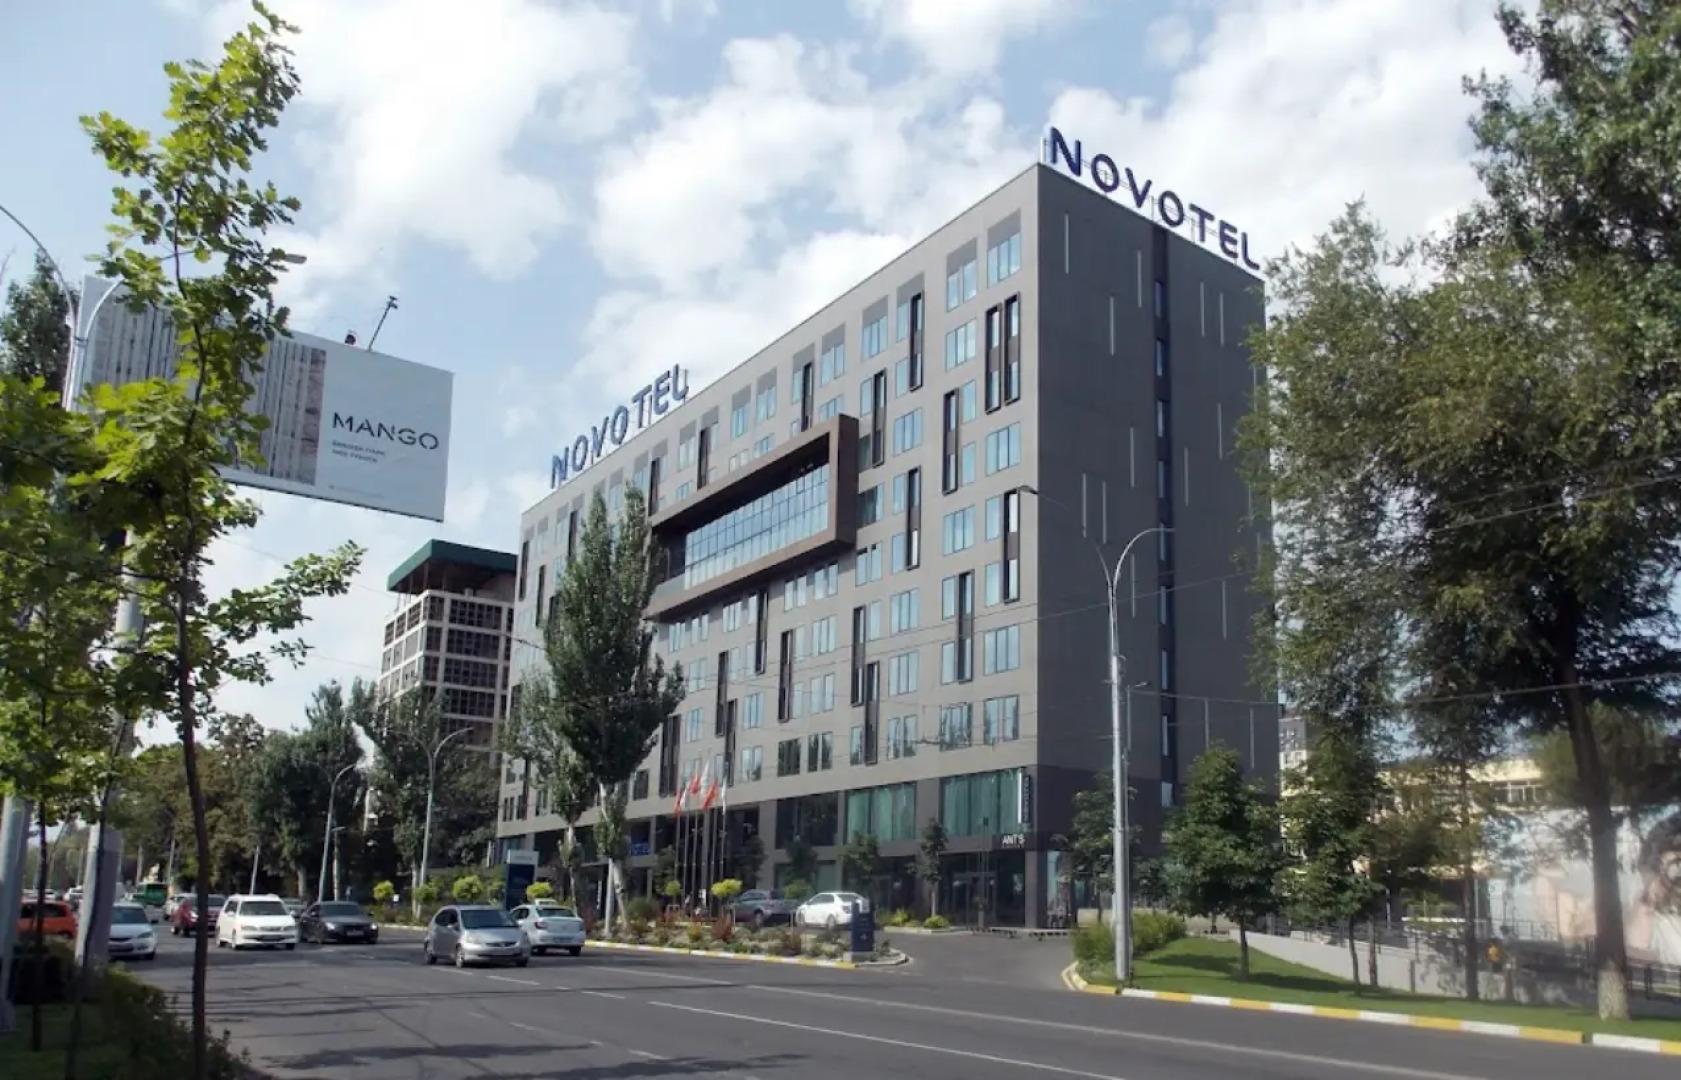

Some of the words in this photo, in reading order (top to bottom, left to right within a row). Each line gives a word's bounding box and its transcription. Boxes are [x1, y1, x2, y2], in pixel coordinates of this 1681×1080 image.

[1050, 126, 1260, 270] NOVOTEL
[332, 411, 439, 450] MANGO
[550, 363, 689, 489] NOVOTEL
